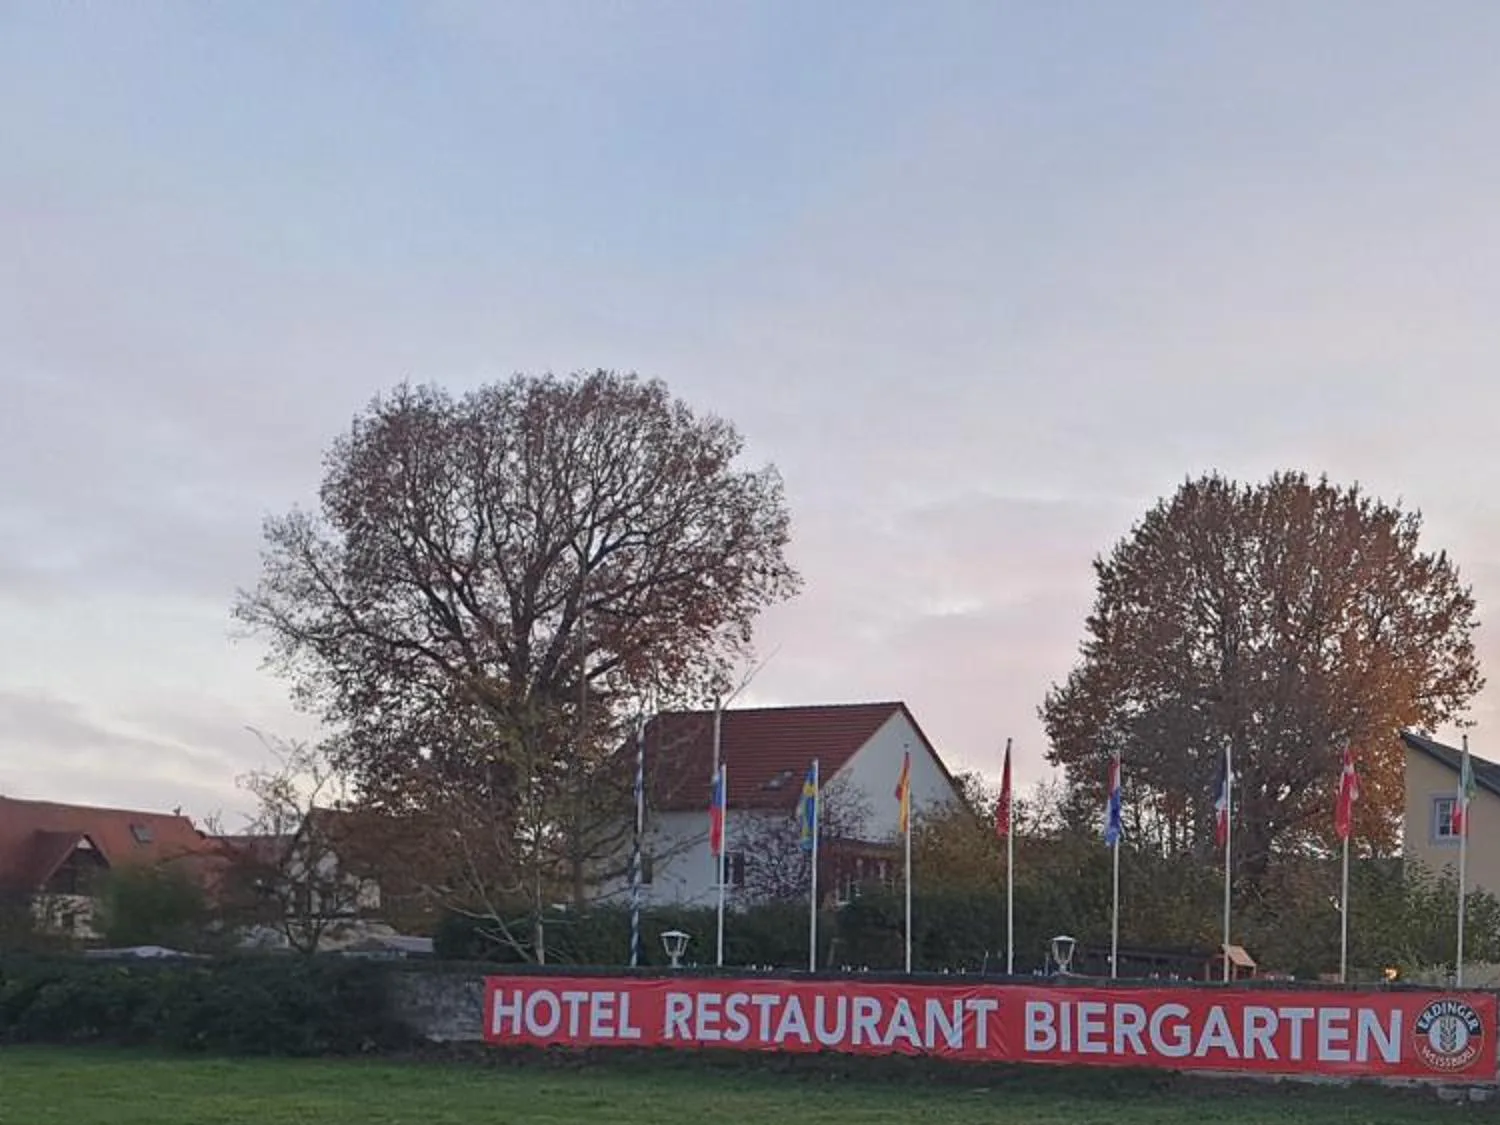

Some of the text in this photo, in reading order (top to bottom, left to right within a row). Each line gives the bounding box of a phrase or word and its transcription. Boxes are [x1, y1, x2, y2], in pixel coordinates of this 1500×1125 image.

[493, 989, 1402, 1063] HOTEL RESTAURANT BIERGARTEN
[1418, 1002, 1479, 1032] ERDINGER
